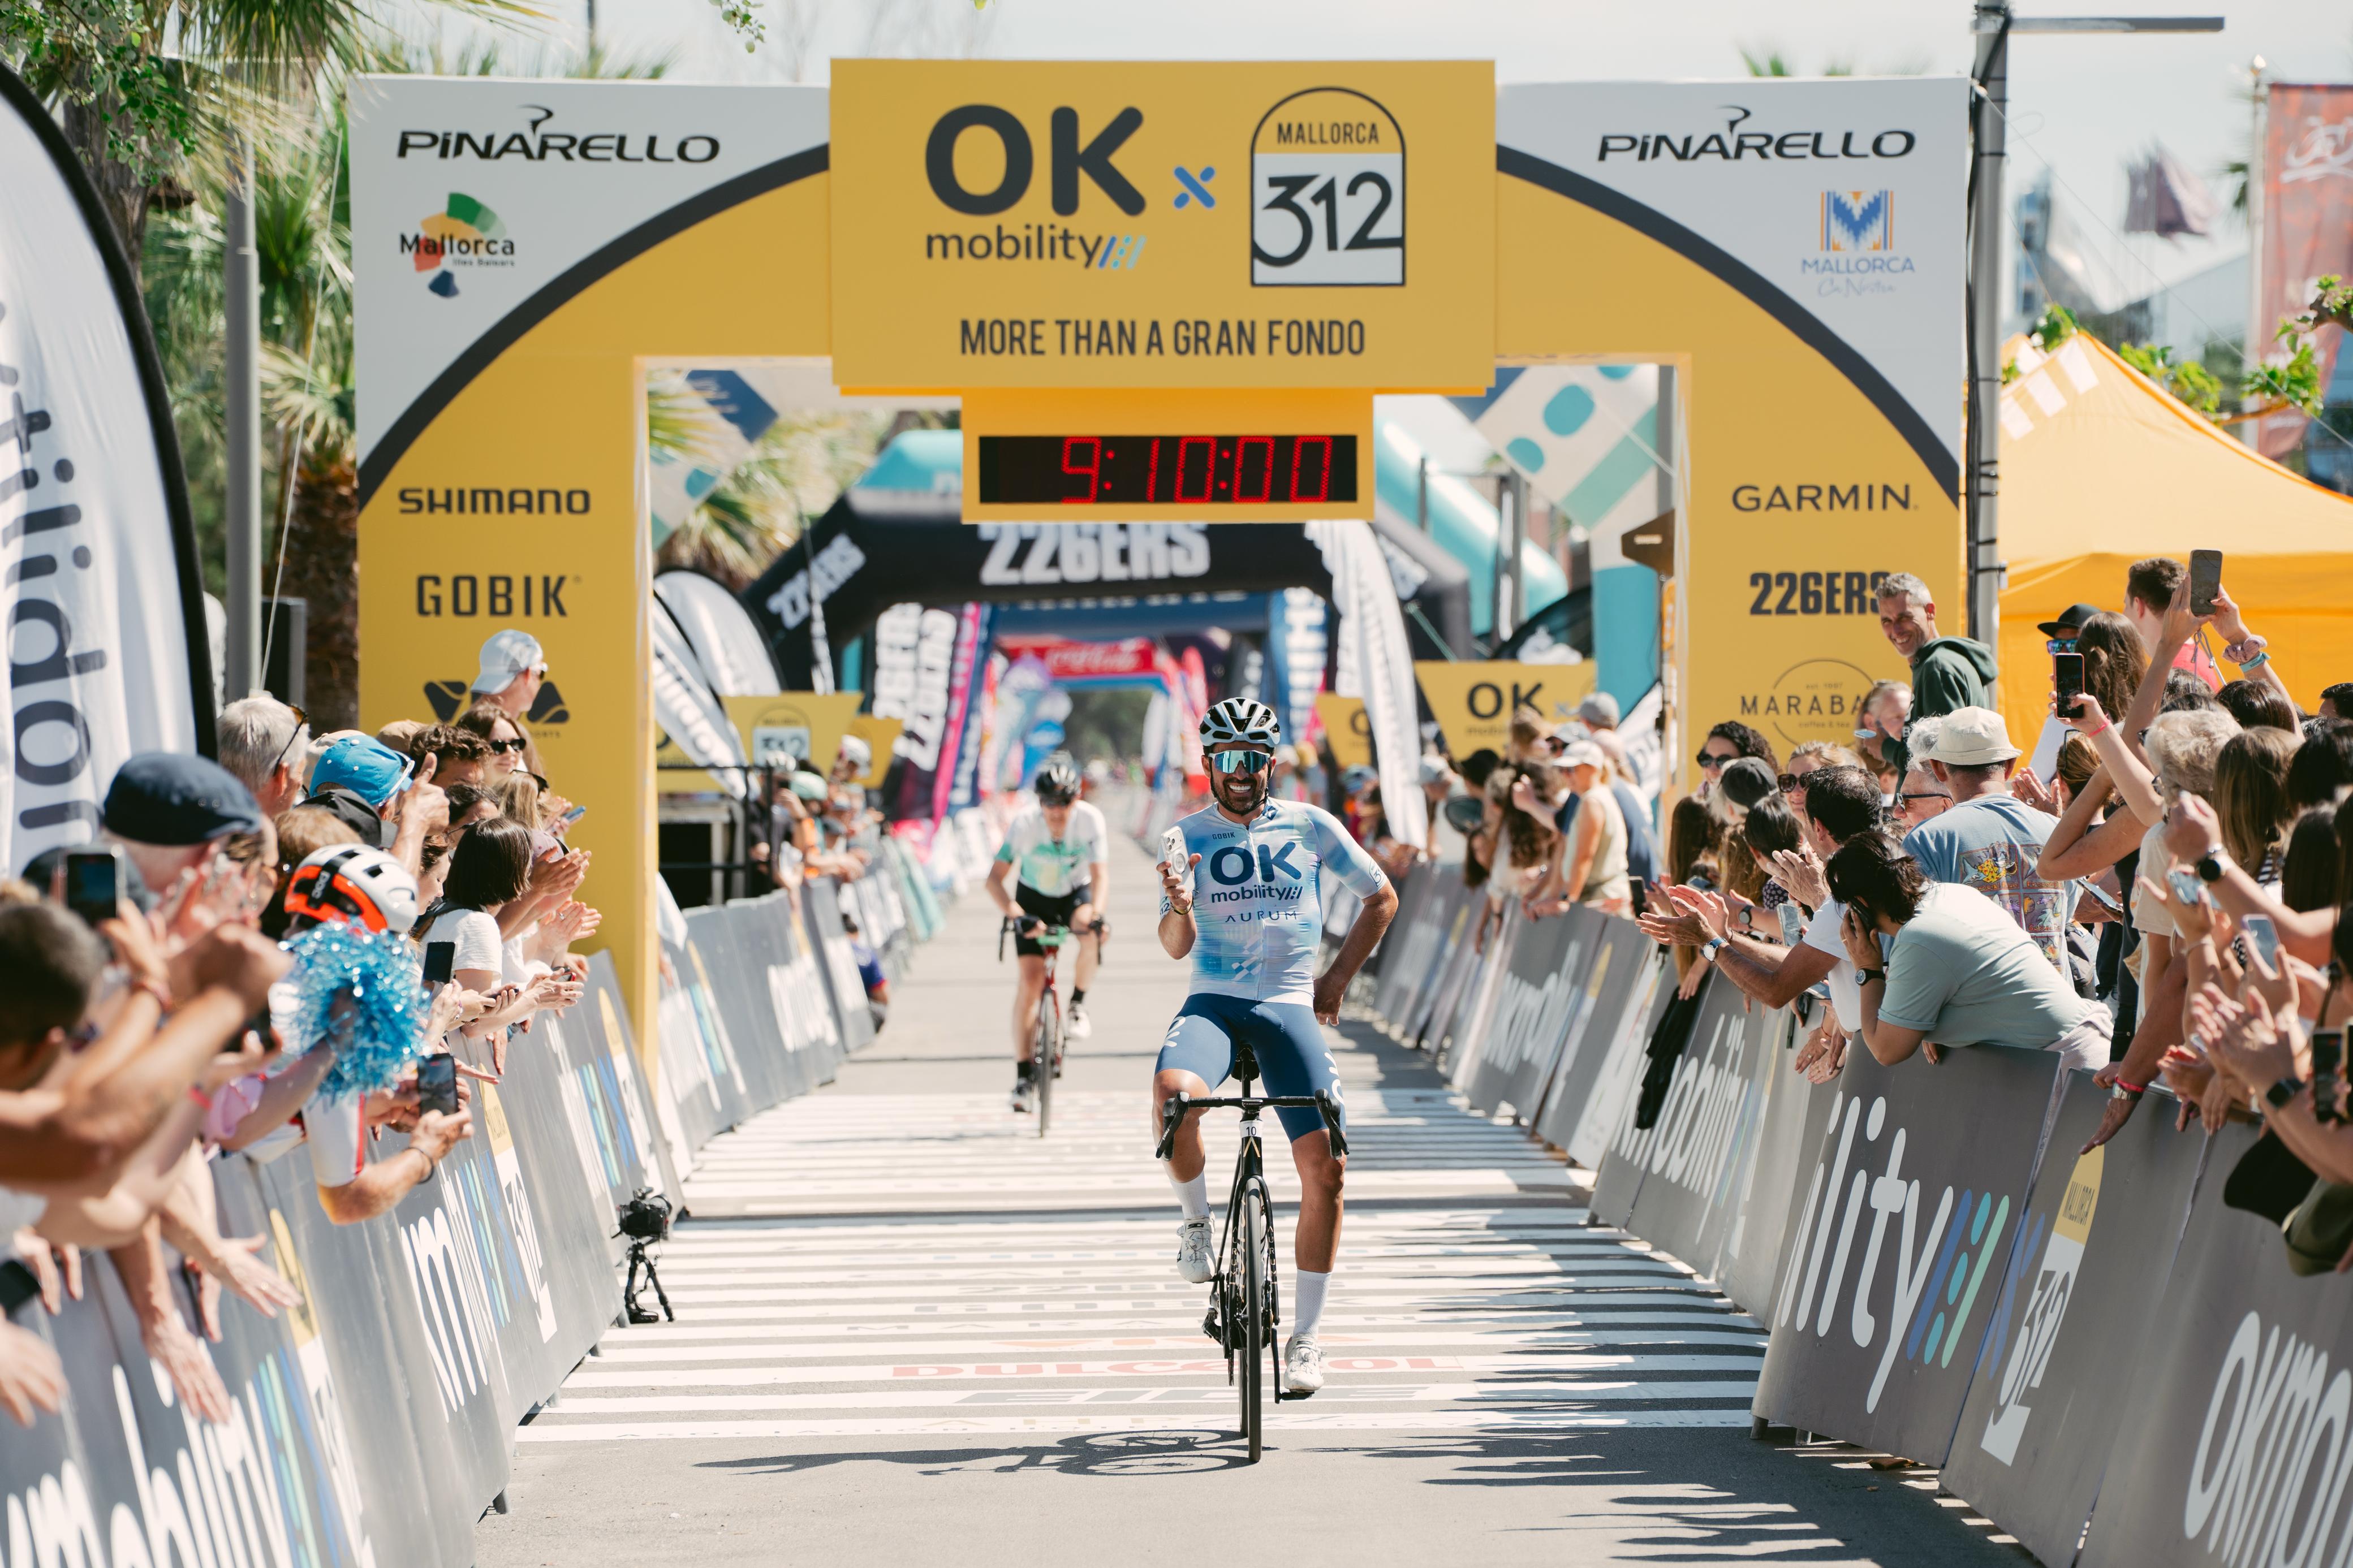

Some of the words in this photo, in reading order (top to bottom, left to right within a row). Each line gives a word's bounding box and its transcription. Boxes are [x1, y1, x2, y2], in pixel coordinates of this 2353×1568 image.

[397, 129, 721, 163] PINARELLO
[1277, 122, 1380, 145] MALLORCA
[1597, 131, 1916, 161] PINARELLO
[925, 104, 1147, 216] OK
[1252, 171, 1404, 267] 312
[399, 232, 515, 256] Mallorca
[925, 224, 1104, 269] mobility
[1801, 257, 1915, 275] MALLORCA
[960, 319, 1046, 356] MORE
[1057, 319, 1137, 356] THAN
[1145, 319, 1165, 356] A
[1174, 319, 1256, 356] GRAN
[1268, 319, 1366, 356] FONDO
[1062, 436, 1333, 504] 9:10:00
[399, 488, 591, 515] SHIMANO
[1732, 483, 1911, 512] GARMIN
[977, 523, 1212, 585] 226ERS
[416, 574, 568, 617] GOBIK
[1467, 682, 1544, 719] OK
[1212, 832, 1235, 840] GOBIK
[1210, 841, 1302, 885] OK
[1211, 884, 1288, 904] mobility
[1225, 910, 1298, 923] AURUM
[1246, 1126, 1257, 1136] 10
